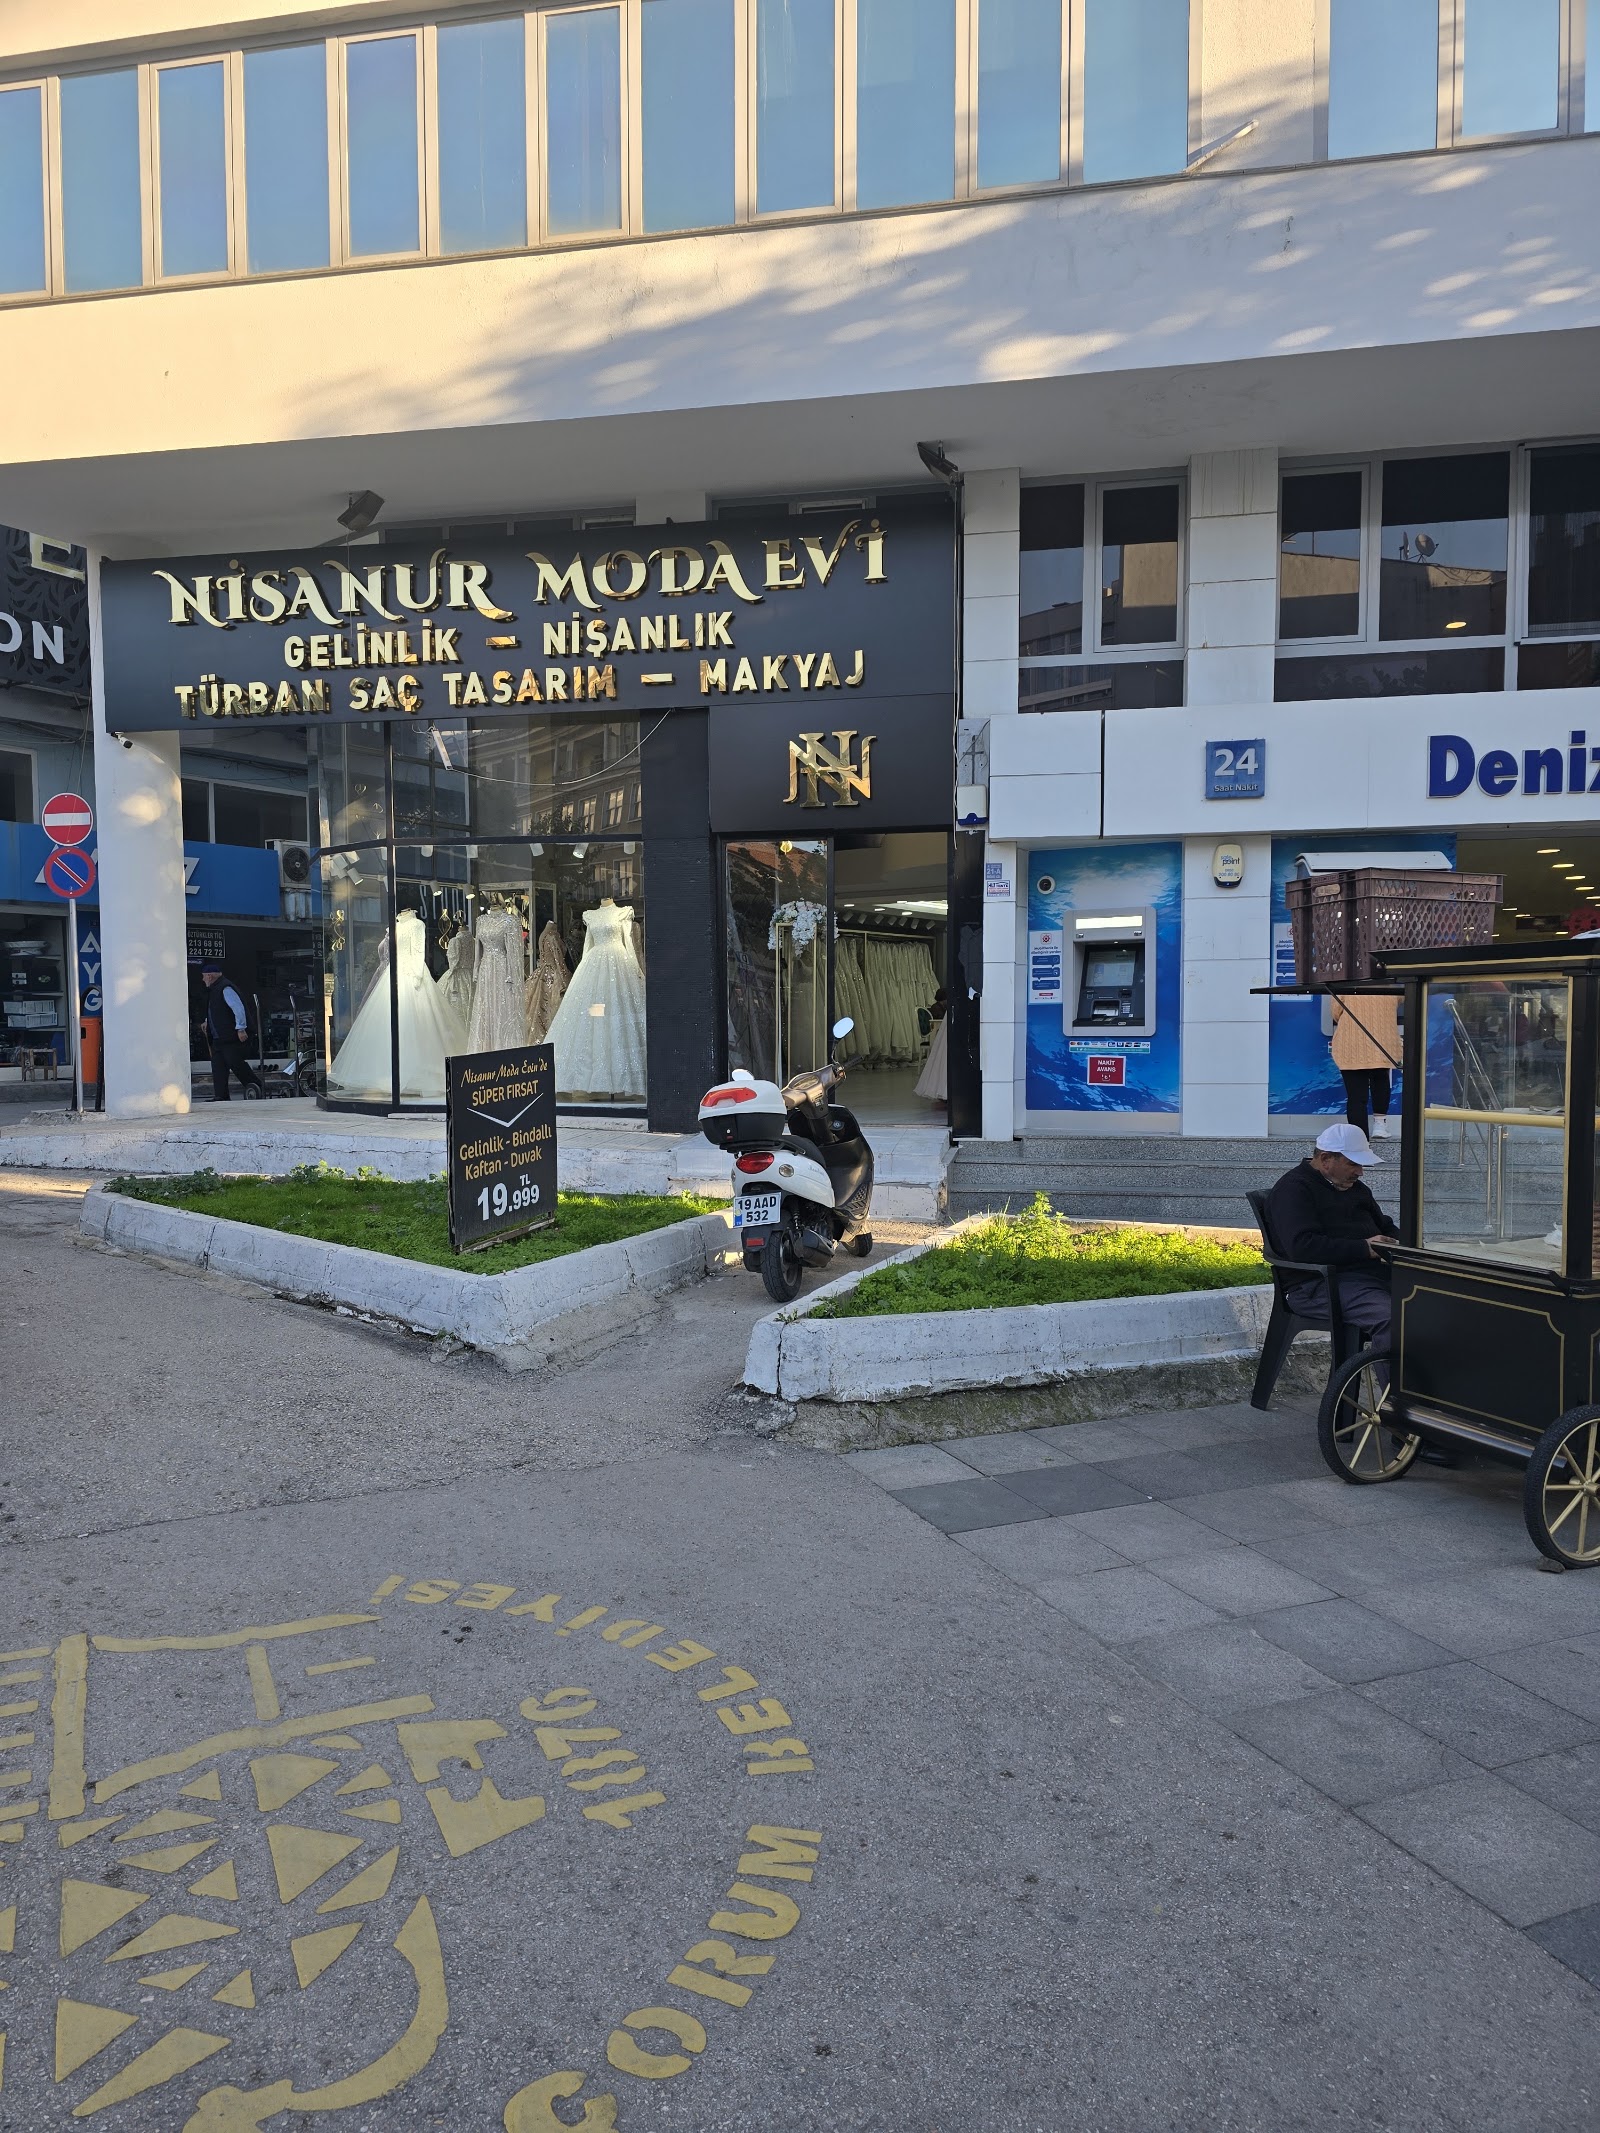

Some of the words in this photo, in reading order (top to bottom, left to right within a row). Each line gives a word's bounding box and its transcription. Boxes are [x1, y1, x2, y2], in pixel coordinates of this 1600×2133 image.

[152, 547, 514, 628] NİSANUR
[284, 618, 460, 669] GELİNLİK
[543, 610, 734, 659] NİŞANLIK
[174, 673, 331, 718] TÜRBAN
[349, 674, 419, 712] SAÇ
[442, 664, 617, 706] TASARIM
[699, 649, 865, 694] MAKYAJ
[1214, 748, 1259, 777] 24
[1214, 784, 1233, 792] Saat
[1235, 783, 1258, 792] Nakit
[188, 939, 202, 947] 213
[203, 948, 213, 956] 72
[460, 1069, 496, 1088] Nisanur
[496, 1063, 520, 1082] Moda
[472, 1086, 505, 1107] SÜPER
[507, 1079, 539, 1101] FIRSAT
[459, 1135, 505, 1161] Gelinlik
[512, 1123, 553, 1148] Bindallı
[465, 1159, 502, 1181] Kaftan
[510, 1145, 543, 1168] Duvak
[519, 1173, 531, 1187] TL
[477, 1182, 540, 1222] 19.999
[738, 1198, 752, 1210] 19
[753, 1196, 777, 1209] AAD
[746, 1209, 769, 1223] 532
[371, 1574, 816, 1776] BELEDİYESİ
